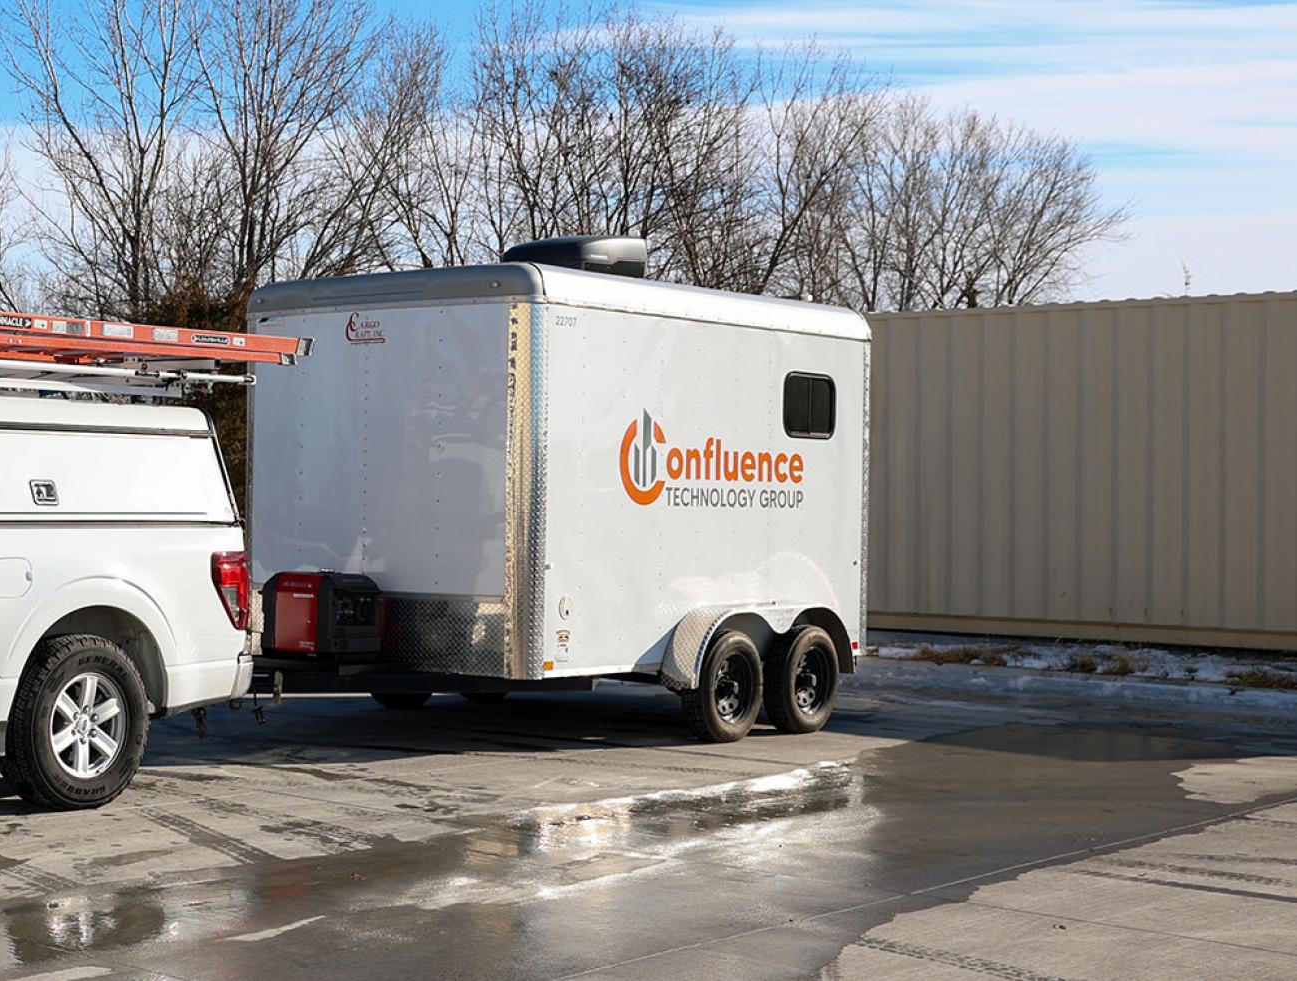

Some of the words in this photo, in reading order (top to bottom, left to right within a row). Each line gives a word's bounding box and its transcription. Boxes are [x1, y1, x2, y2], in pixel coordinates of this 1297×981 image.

[555, 315, 578, 326] 22707
[620, 408, 804, 505] Confluence
[665, 486, 756, 508] TECHNOLOGY
[759, 488, 804, 509] GROUP
